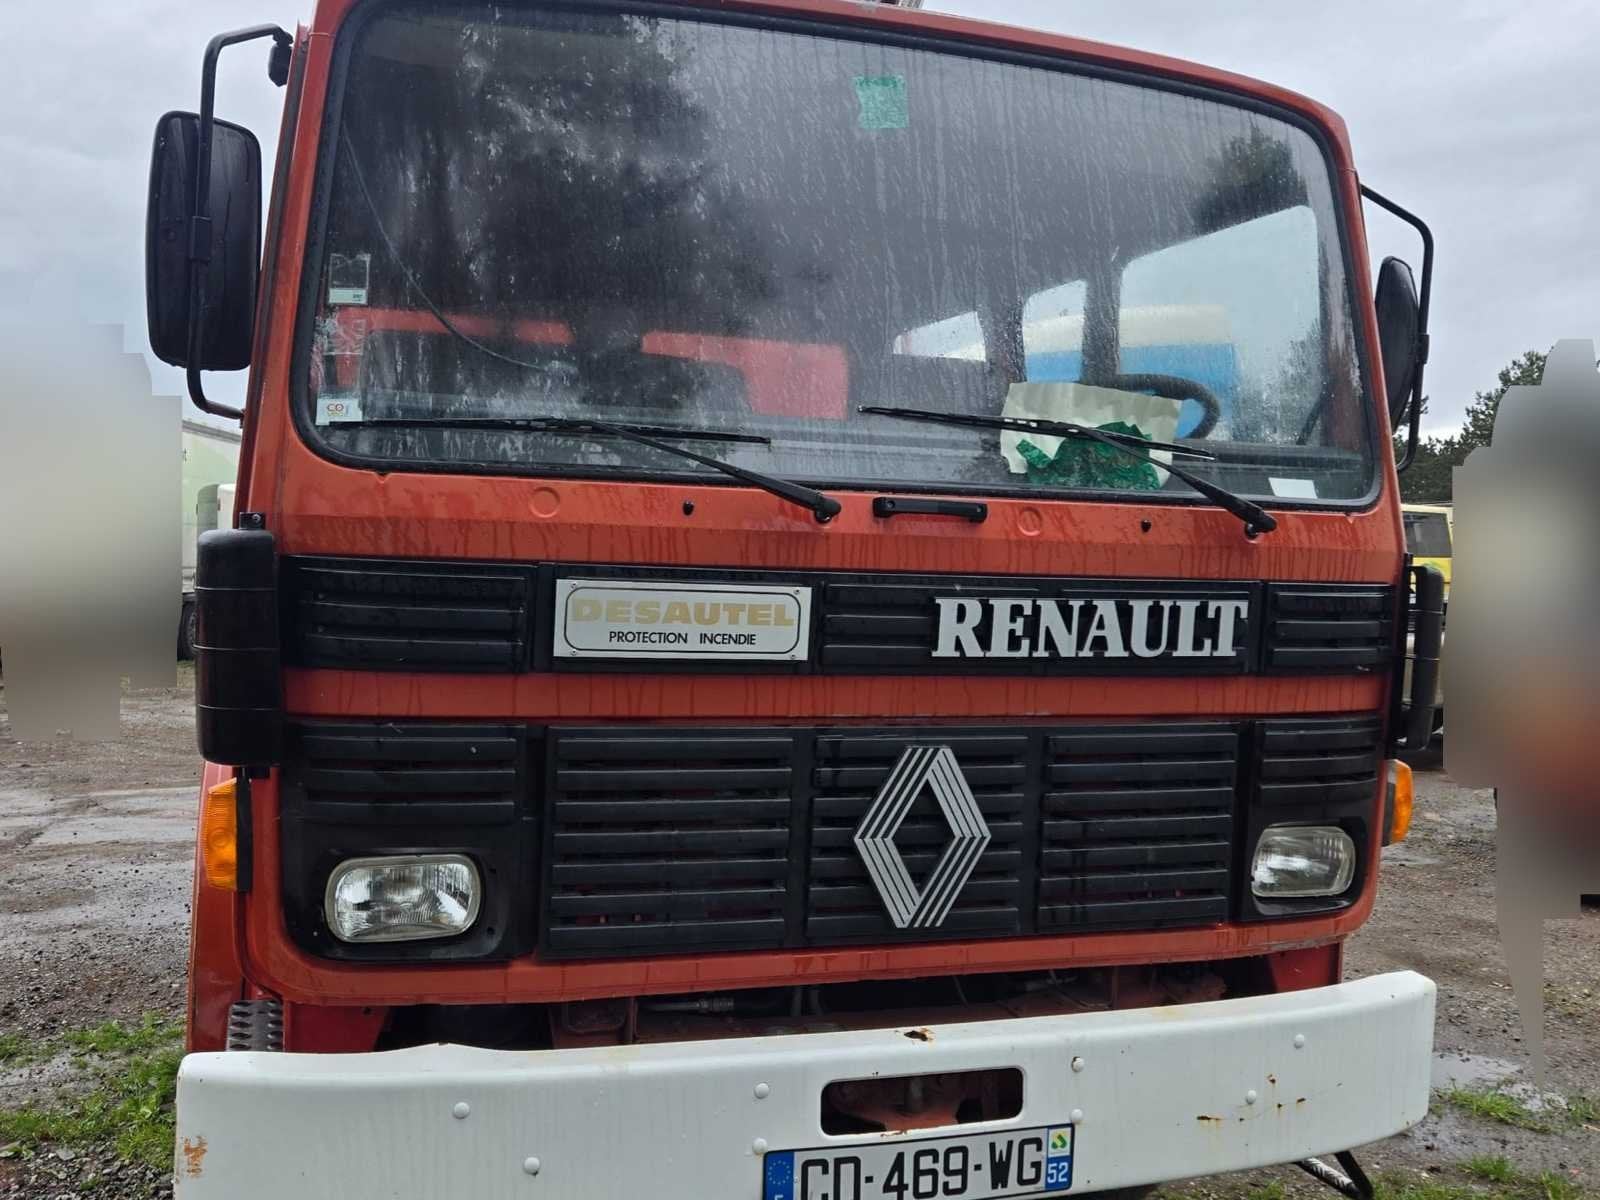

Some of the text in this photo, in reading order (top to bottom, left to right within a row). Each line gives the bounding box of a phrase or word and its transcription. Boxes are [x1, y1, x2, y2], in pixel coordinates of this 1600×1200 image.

[570, 600, 794, 626] DESAUTEL
[609, 631, 756, 645] PROTECTION INCENDIE
[931, 597, 1249, 658] RENAULT
[801, 1137, 1043, 1200] CD-469-WG
[1047, 1161, 1069, 1184] 52
